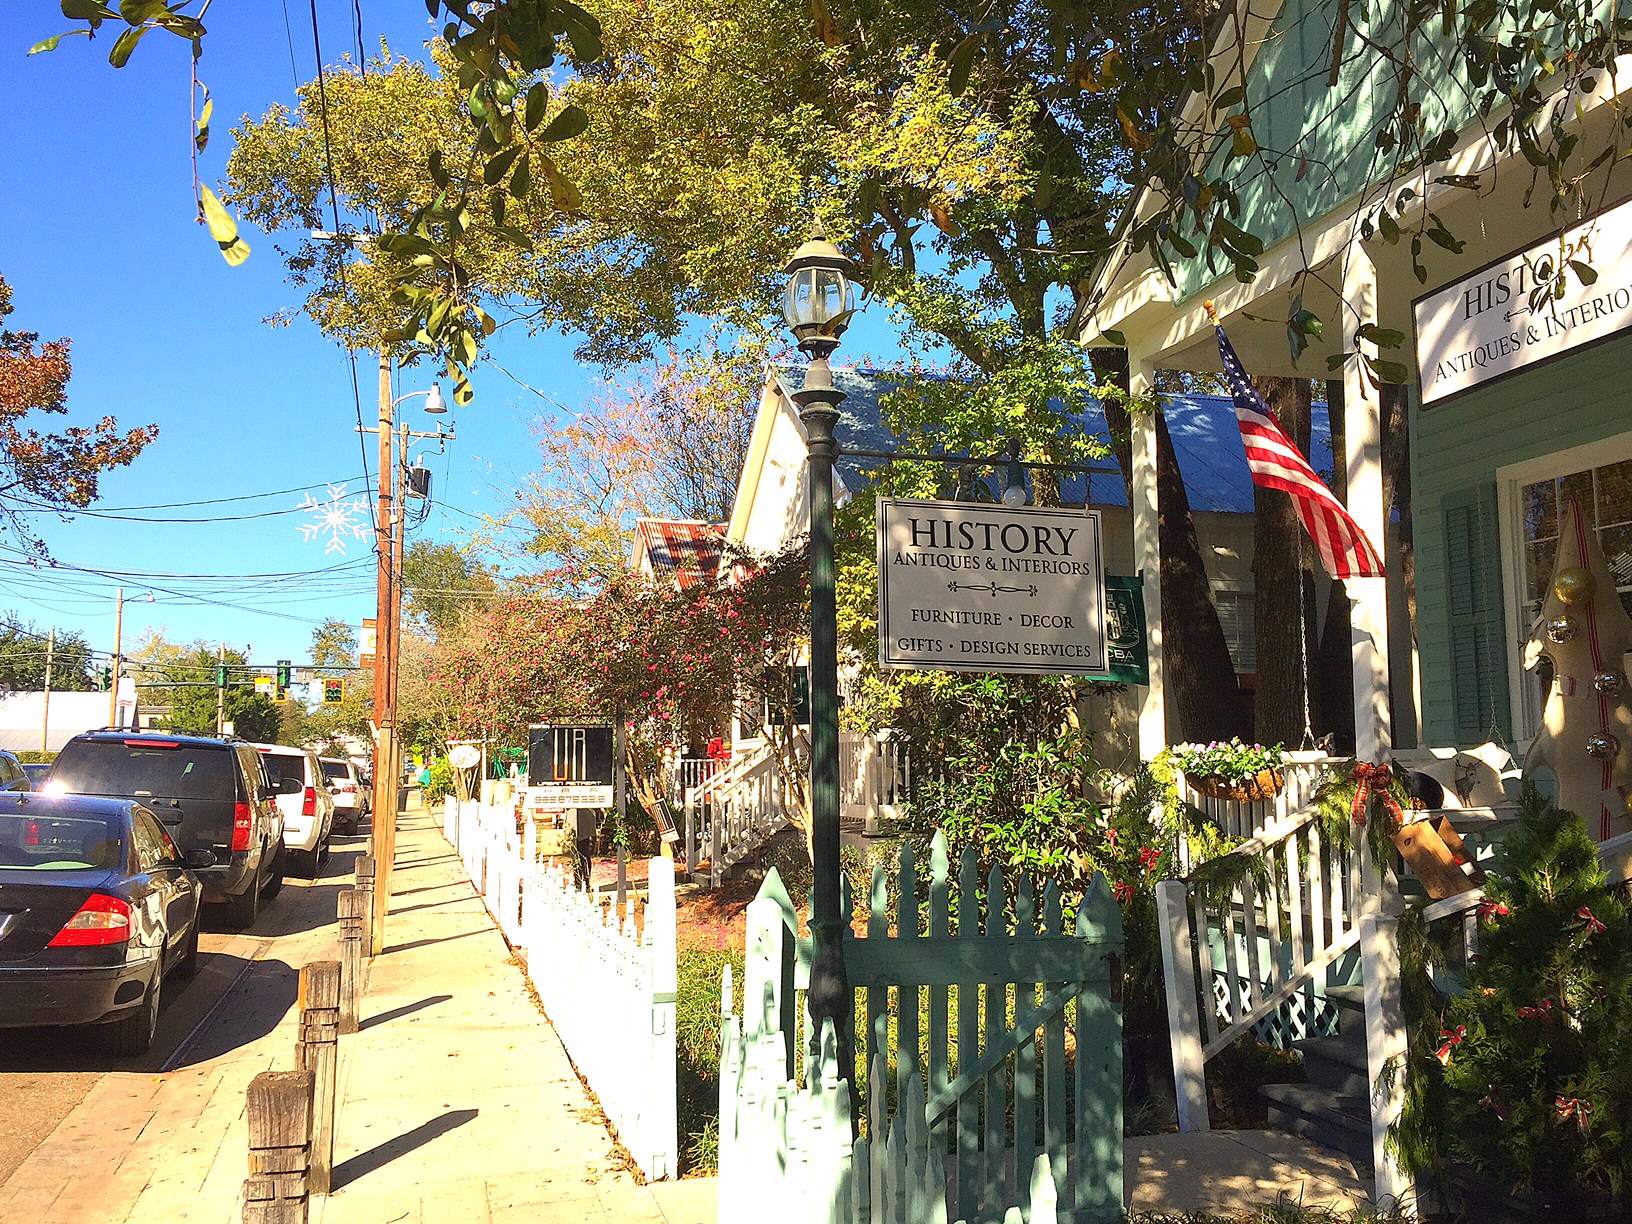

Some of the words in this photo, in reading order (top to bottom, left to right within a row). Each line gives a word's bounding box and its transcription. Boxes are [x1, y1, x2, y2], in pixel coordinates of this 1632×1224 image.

[1464, 228, 1602, 321] HISTORY
[1435, 332, 1521, 383] ANTIQUES
[1526, 325, 1540, 345] &
[1544, 284, 1632, 338] INTERIO
[908, 518, 1078, 556] HISTORY
[893, 552, 980, 572] ANTIQUES
[986, 557, 998, 571] &
[1002, 558, 1090, 576] INTERIORS
[911, 609, 1002, 626] FURNITURE
[1020, 614, 1074, 629] DECOR
[897, 638, 942, 652] GIFTS
[960, 640, 1019, 655] DESIGN
[1024, 643, 1091, 657] SERVICES
[553, 728, 586, 781] UR
